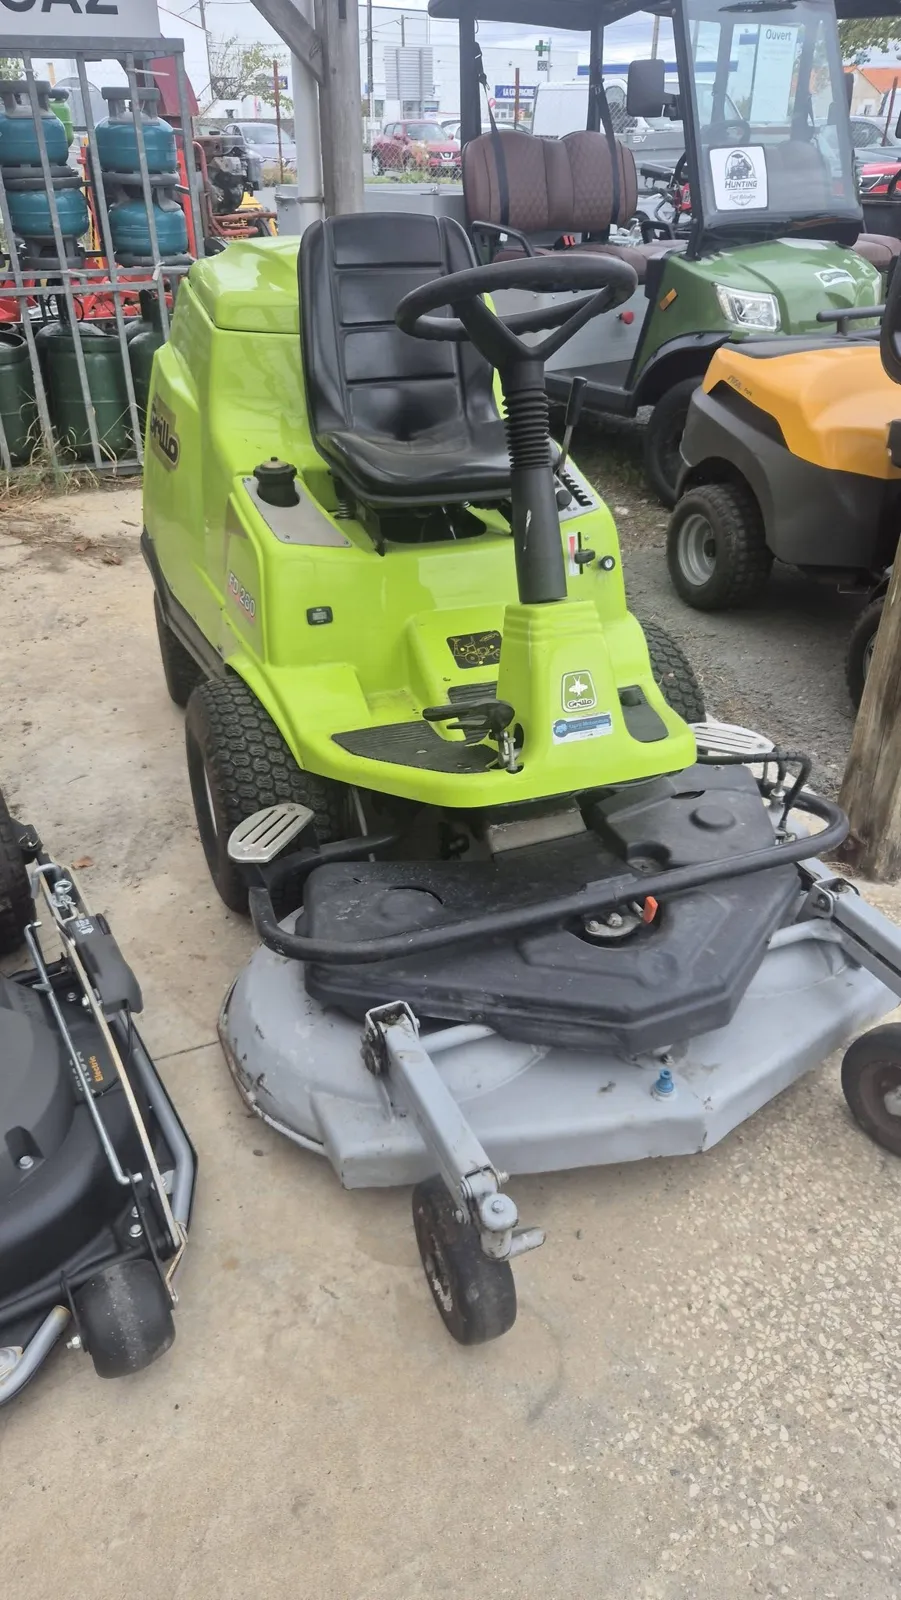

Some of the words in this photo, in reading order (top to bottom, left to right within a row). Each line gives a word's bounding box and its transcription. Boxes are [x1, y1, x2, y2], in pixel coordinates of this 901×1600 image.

[765, 28, 793, 41] Ouvert
[724, 180, 758, 189] HUNTING
[568, 699, 592, 707] Grillo
[89, 1055, 104, 1082] Electric
